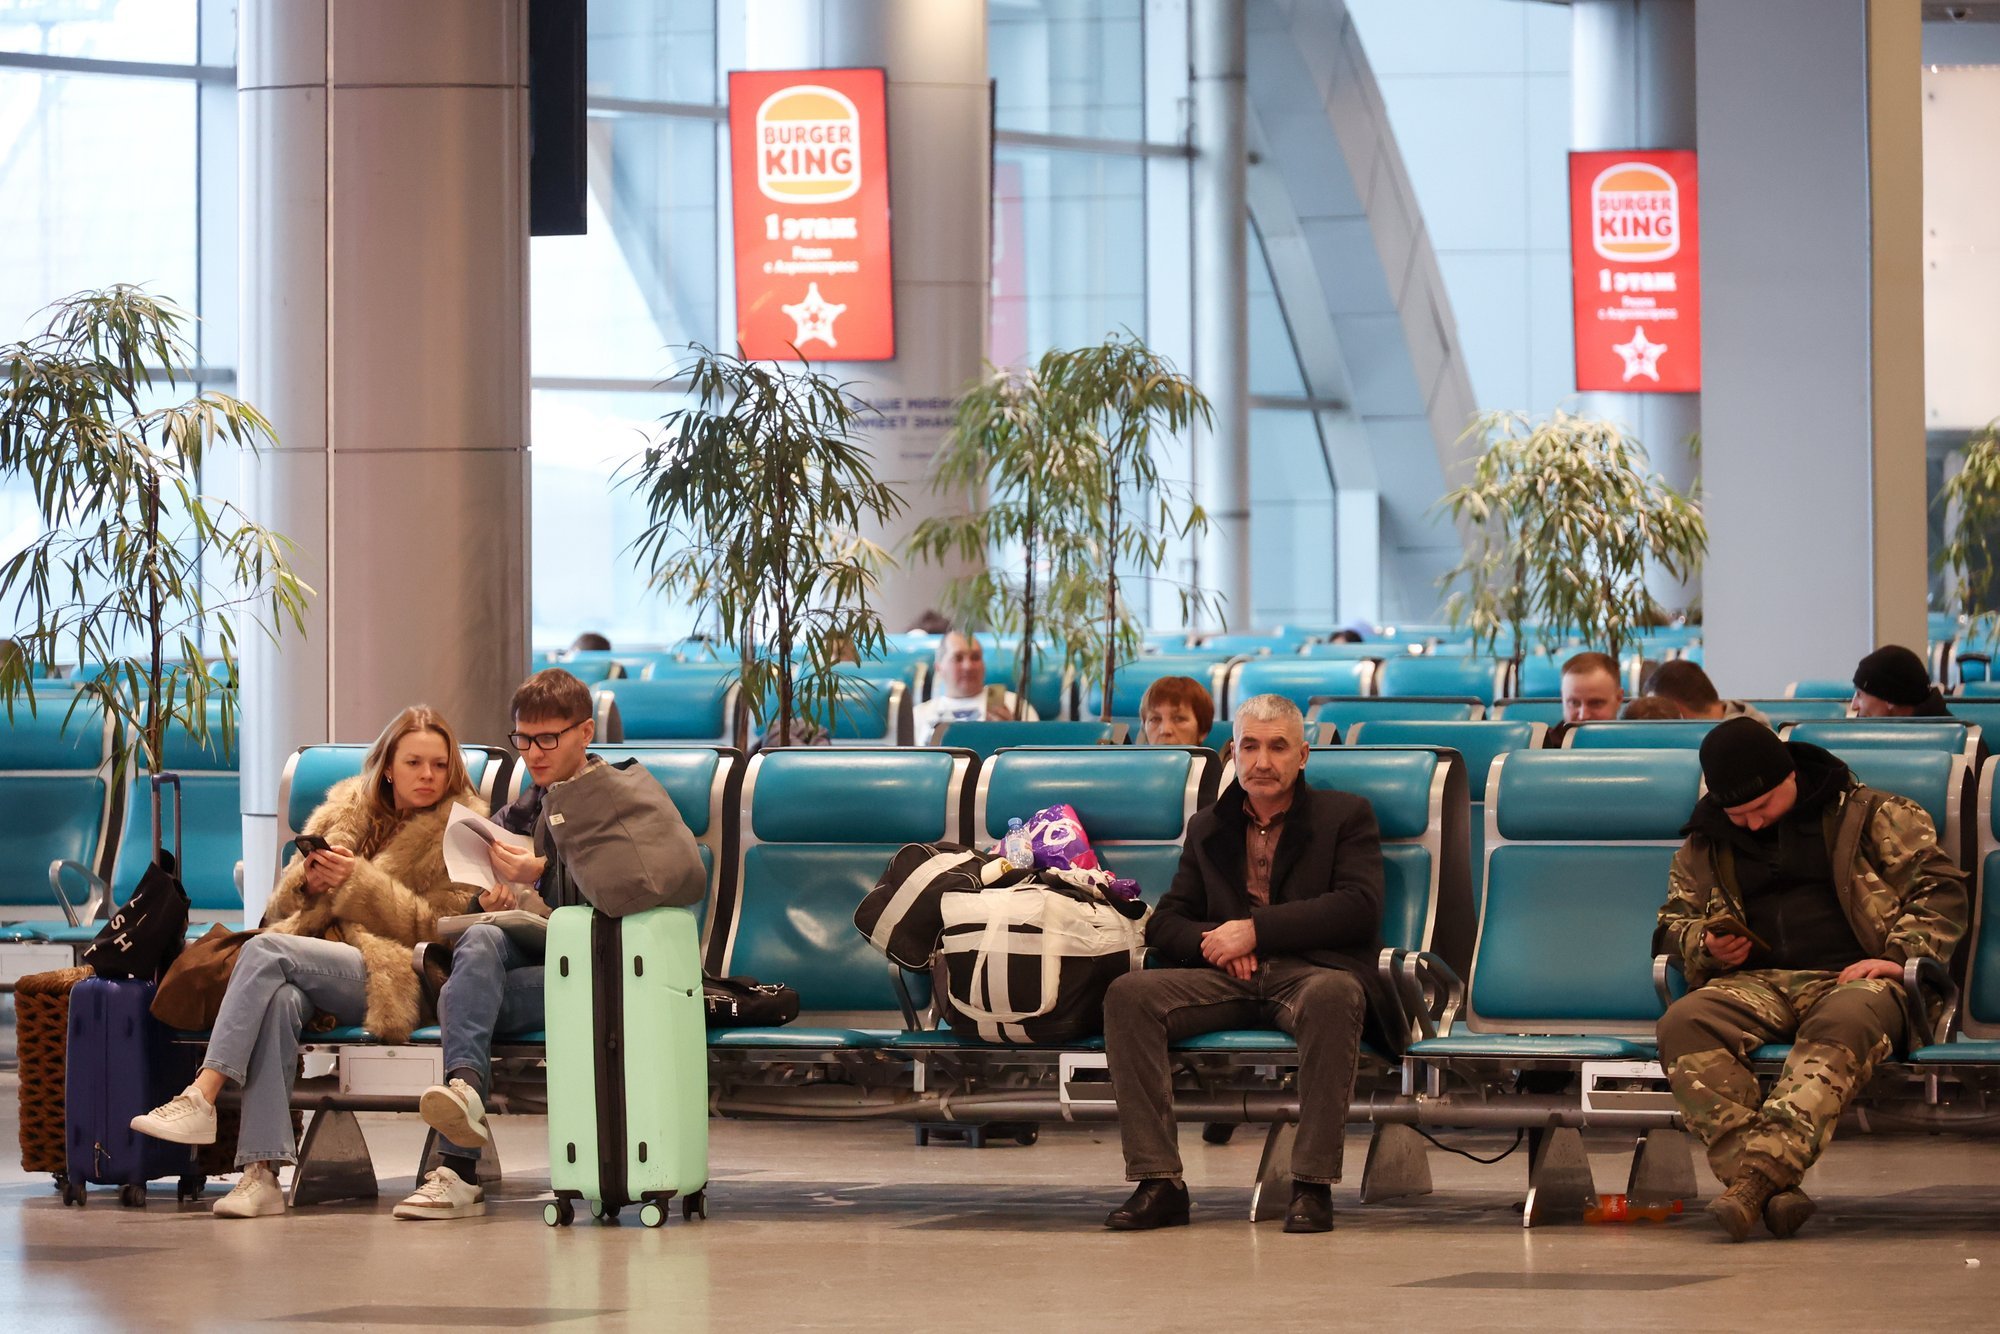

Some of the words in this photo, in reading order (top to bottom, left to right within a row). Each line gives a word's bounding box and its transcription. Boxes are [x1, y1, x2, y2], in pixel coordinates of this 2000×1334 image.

[764, 126, 852, 144] BURGER
[765, 148, 852, 175] KING
[1599, 197, 1672, 211] BURGER
[765, 214, 779, 240] 1
[1600, 216, 1672, 237] KING
[1599, 268, 1612, 292] 1
